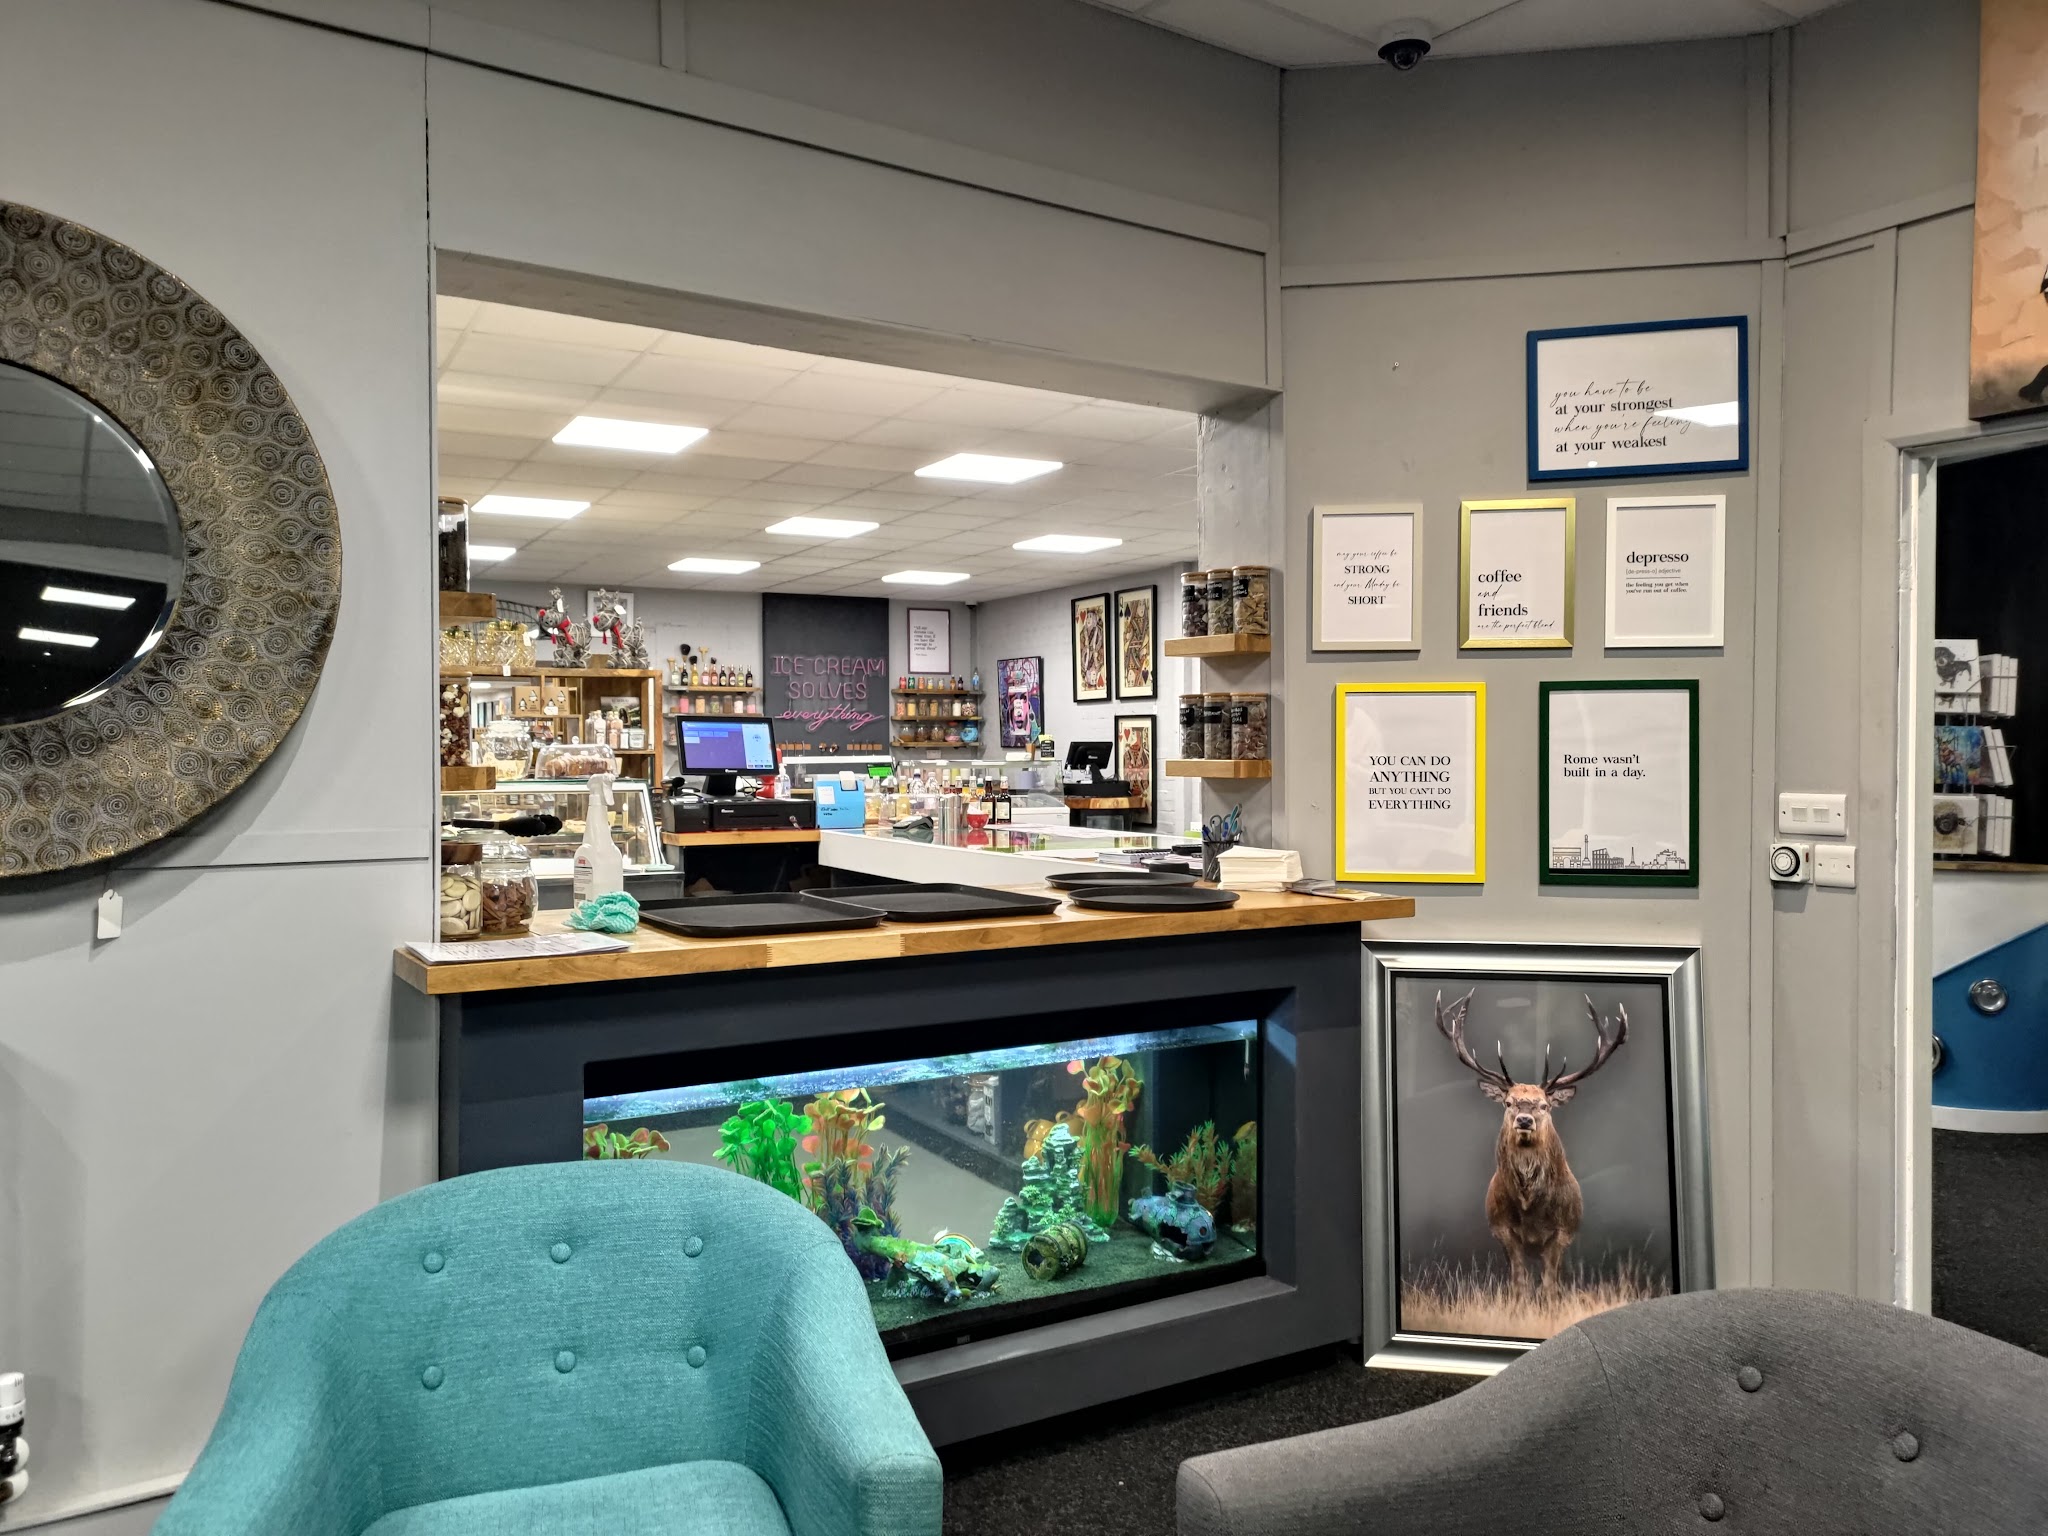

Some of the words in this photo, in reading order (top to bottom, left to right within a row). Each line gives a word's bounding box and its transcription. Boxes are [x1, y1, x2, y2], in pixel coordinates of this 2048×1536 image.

[1550, 390, 1580, 407] you
[1584, 382, 1615, 396] have
[1616, 378, 1638, 398] to
[1637, 380, 1653, 395] be
[1555, 404, 1567, 415] at
[1574, 403, 1605, 417] your
[1611, 397, 1673, 412] strongest
[1554, 416, 1590, 433] when
[1591, 414, 1637, 439] you're
[1640, 416, 1693, 436] feeling
[1556, 442, 1567, 452] at
[1574, 441, 1606, 455] your
[1612, 435, 1667, 449] weakest
[1371, 550, 1387, 560] coffee
[1626, 551, 1689, 567] depresso
[1344, 565, 1390, 574] STRONG
[1478, 570, 1522, 583] coffee
[1334, 580, 1346, 588] and
[1478, 584, 1502, 600] and
[1348, 596, 1386, 605] SHORT
[1478, 604, 1528, 616] friends
[773, 656, 804, 674] ICE
[814, 656, 885, 675] CREAM
[788, 681, 867, 699] SOLVES
[775, 703, 885, 731] everything
[1369, 756, 1396, 765] YOU
[1400, 756, 1426, 766] CAN
[1431, 756, 1451, 765] DO
[1564, 754, 1598, 764] Rome
[1603, 754, 1640, 764] wasn't
[1369, 771, 1450, 782] ANYTHING
[1564, 767, 1590, 777] built
[1595, 767, 1606, 777] in
[1611, 769, 1617, 777] a
[1623, 767, 1646, 780] day.
[1369, 800, 1451, 810] EVERYTHING
